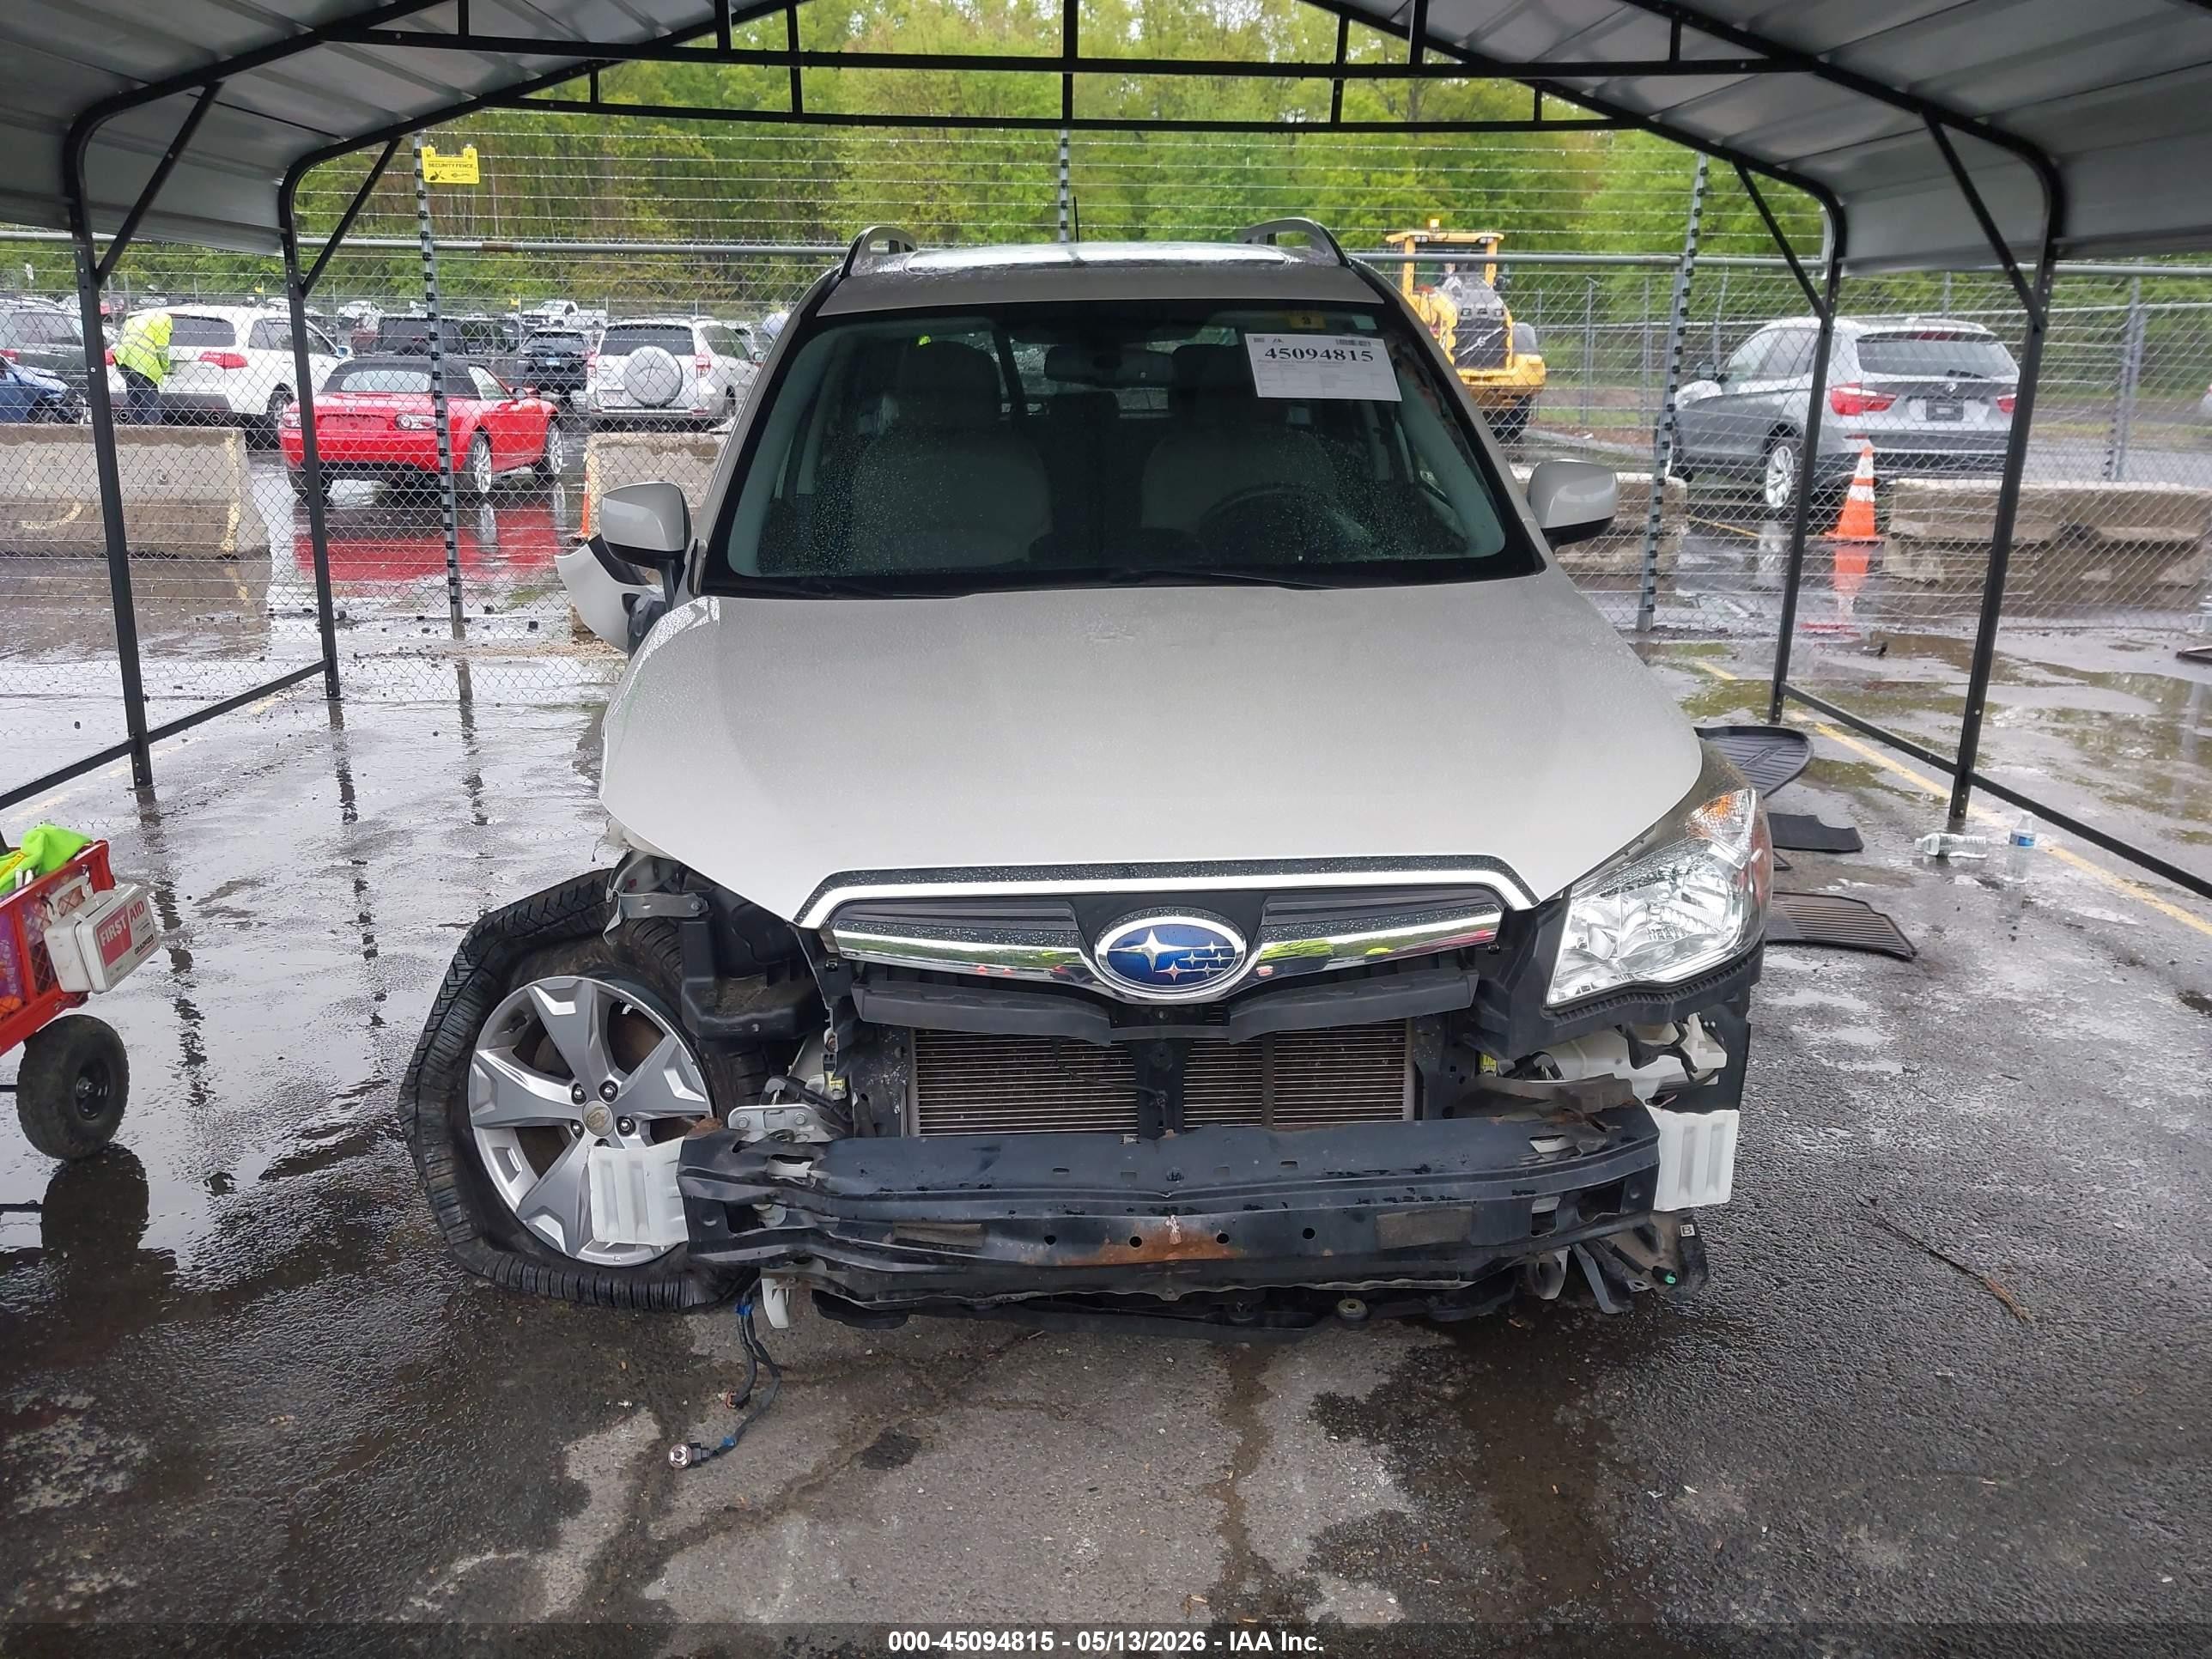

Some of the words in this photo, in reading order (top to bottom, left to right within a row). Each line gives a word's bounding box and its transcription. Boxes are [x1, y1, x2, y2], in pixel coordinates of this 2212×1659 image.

[1265, 347, 1374, 362] 45094815
[100, 915, 127, 946] FIRST
[129, 900, 145, 922] AID
[1682, 1226, 1692, 1235] B
